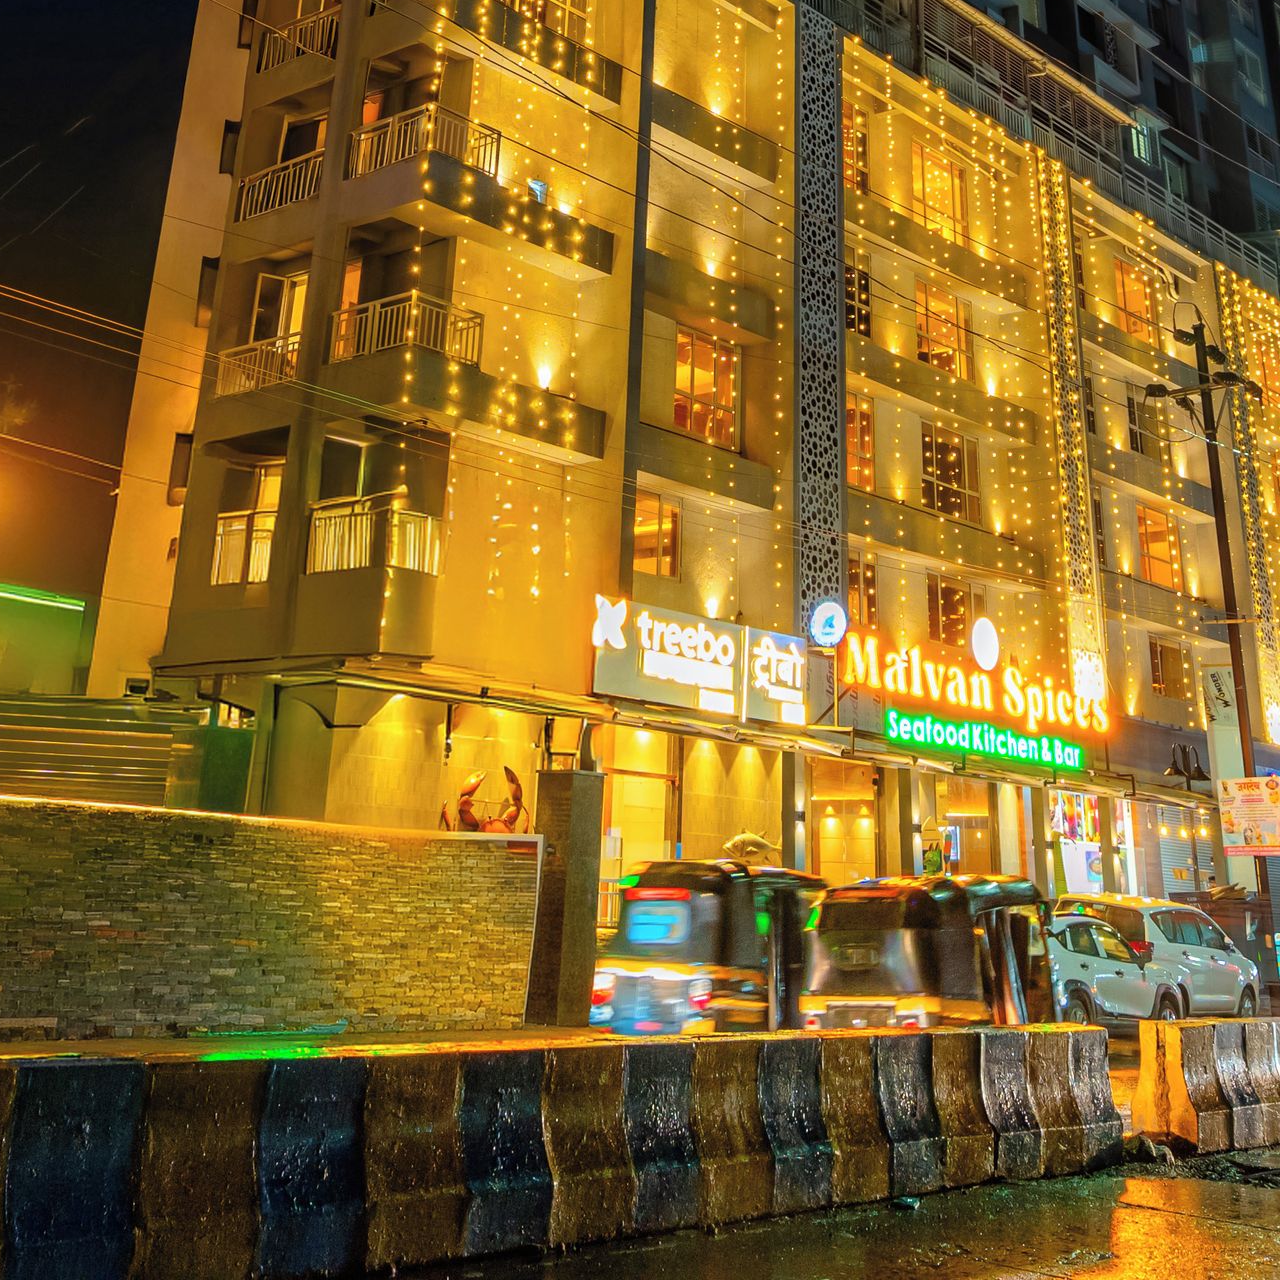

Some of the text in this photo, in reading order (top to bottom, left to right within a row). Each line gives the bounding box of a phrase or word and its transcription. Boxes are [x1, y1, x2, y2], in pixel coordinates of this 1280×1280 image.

[636, 610, 735, 666] treebo
[843, 631, 994, 711] Malvan
[1002, 665, 1111, 733] Spices
[887, 710, 1081, 767] Seafood Kitchen & Bar
